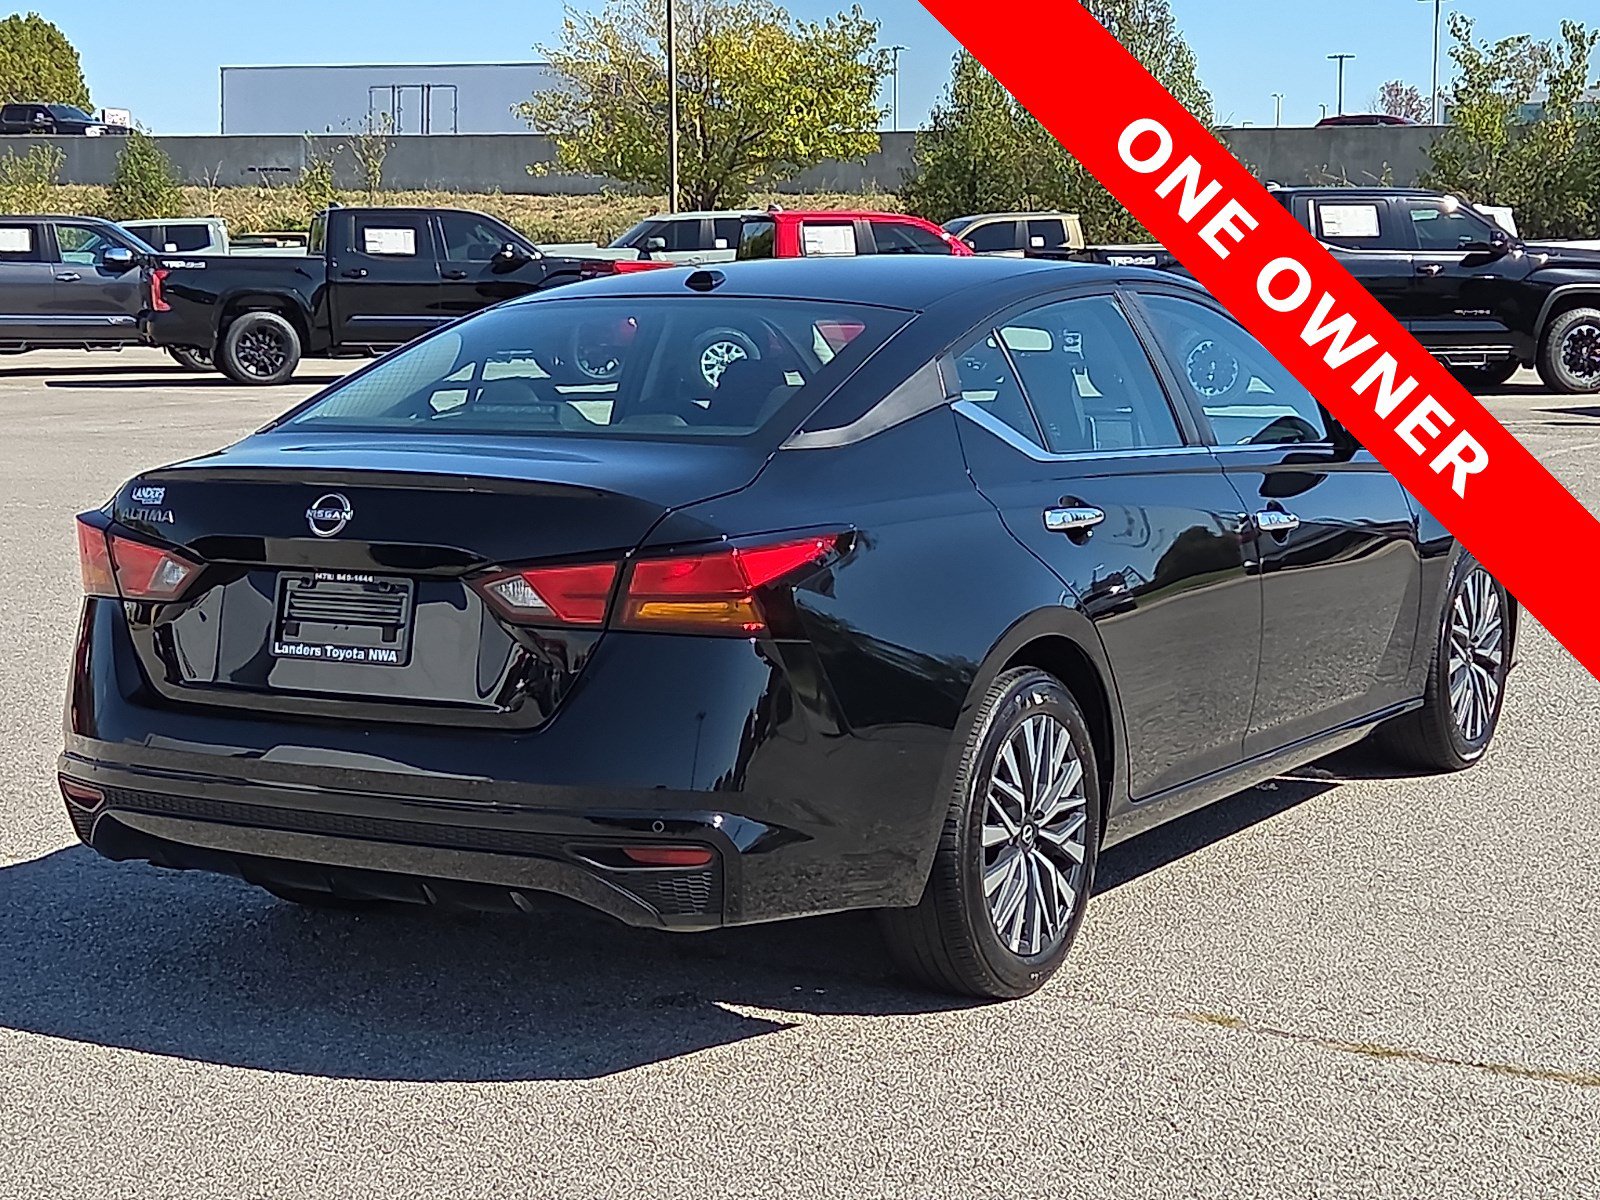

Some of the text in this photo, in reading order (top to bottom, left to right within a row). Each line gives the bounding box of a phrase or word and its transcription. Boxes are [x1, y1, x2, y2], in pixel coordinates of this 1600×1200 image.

[132, 487, 166, 501] LANDERS
[120, 508, 174, 523] ALTIMA
[305, 509, 354, 520] NISSAN
[274, 641, 397, 663] Landers Toyota NWA
